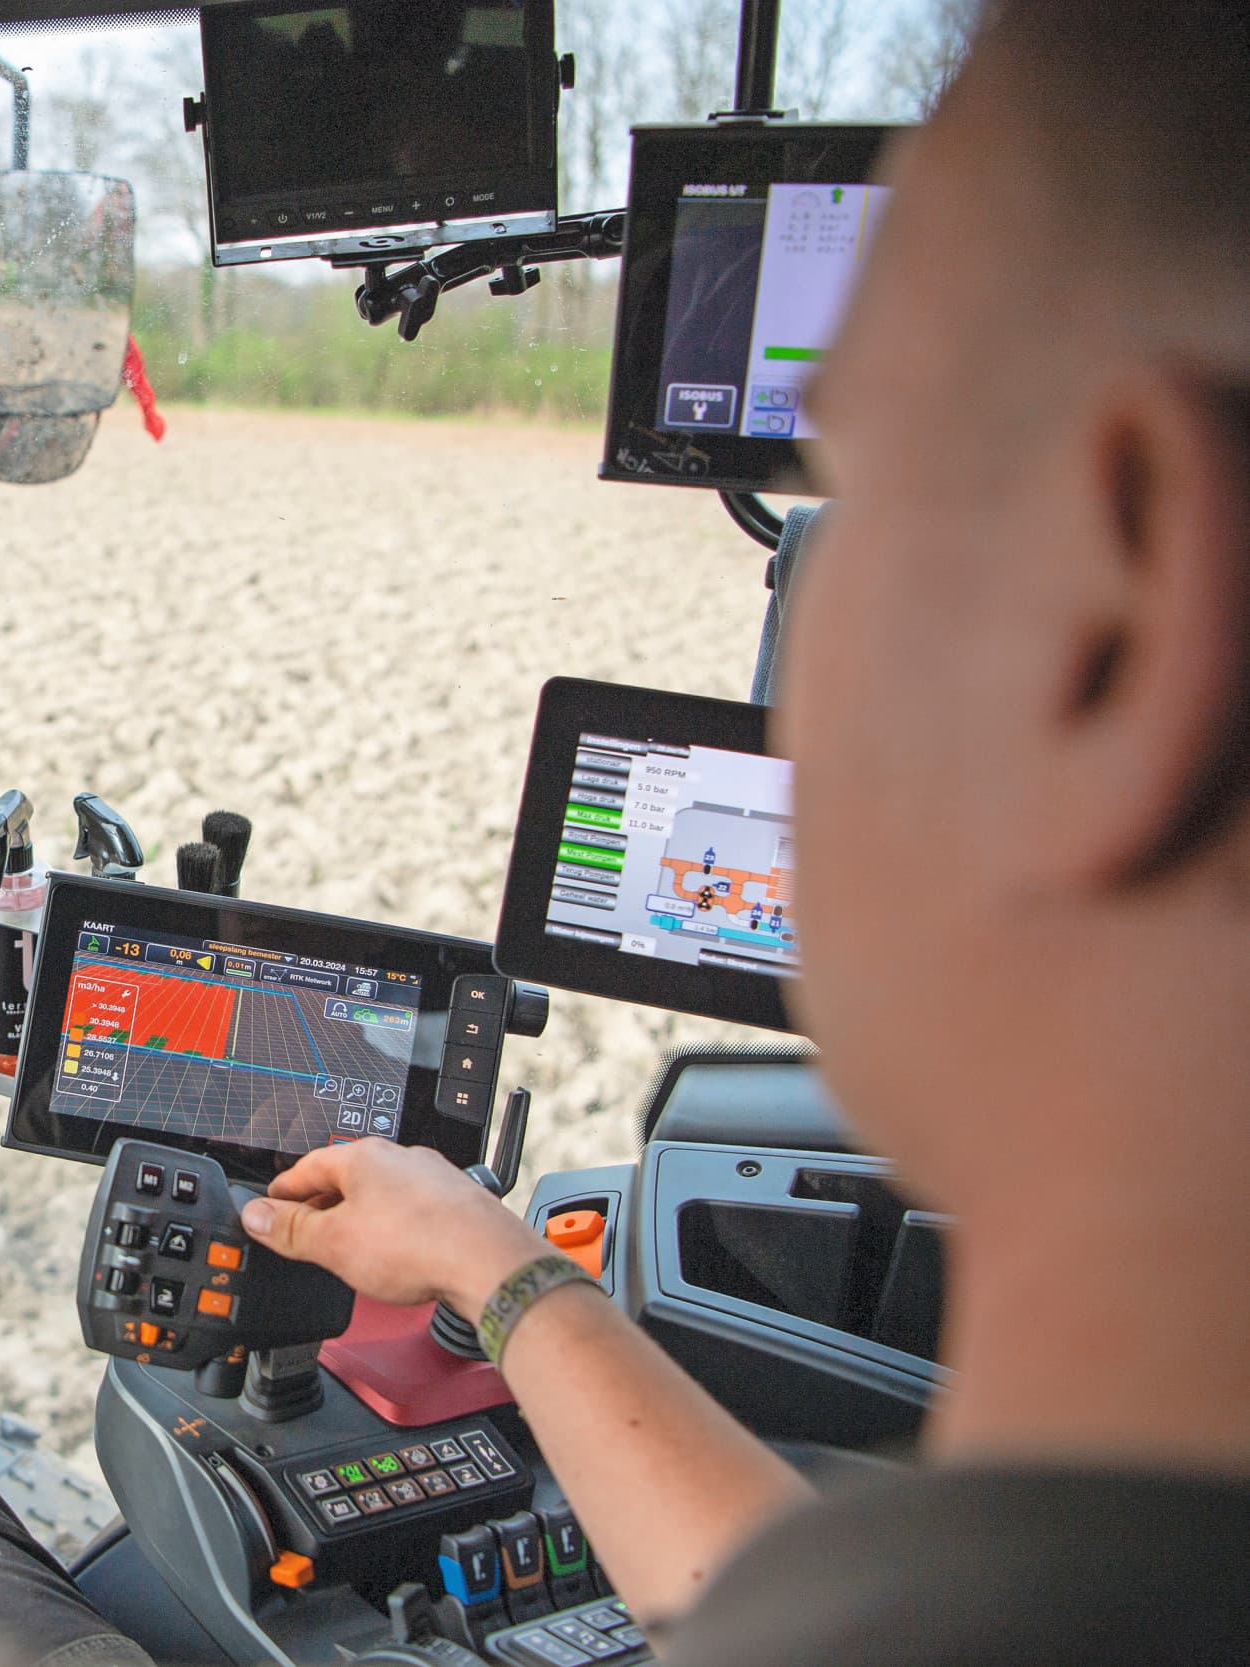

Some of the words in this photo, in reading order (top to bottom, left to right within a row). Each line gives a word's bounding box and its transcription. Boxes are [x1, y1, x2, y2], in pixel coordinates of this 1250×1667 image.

[473, 192, 495, 202] MODE
[372, 205, 394, 214] MENU
[306, 211, 327, 220] V1/V2
[679, 389, 724, 402] ISOBUS
[645, 766, 663, 776] 950
[664, 768, 686, 778] RPM
[637, 783, 652, 792] 5.0
[653, 785, 669, 794] bar
[634, 802, 648, 810] 7.0
[650, 804, 666, 813] bar
[629, 819, 647, 829] 11.0
[648, 822, 665, 832] bar
[84, 920, 115, 933] KAART
[115, 942, 140, 956] -13
[208, 943, 247, 956] sleepslang
[248, 948, 282, 960] bemester
[300, 957, 346, 972] 20.03.2024
[354, 966, 378, 977] 15:57
[290, 974, 304, 982] RTK
[304, 976, 332, 986] Network
[78, 982, 106, 993] m3/ha
[470, 990, 486, 1000] OK
[330, 1010, 348, 1018] AUTO
[80, 1083, 98, 1093] 0.40
[341, 1110, 362, 1126] 2D
